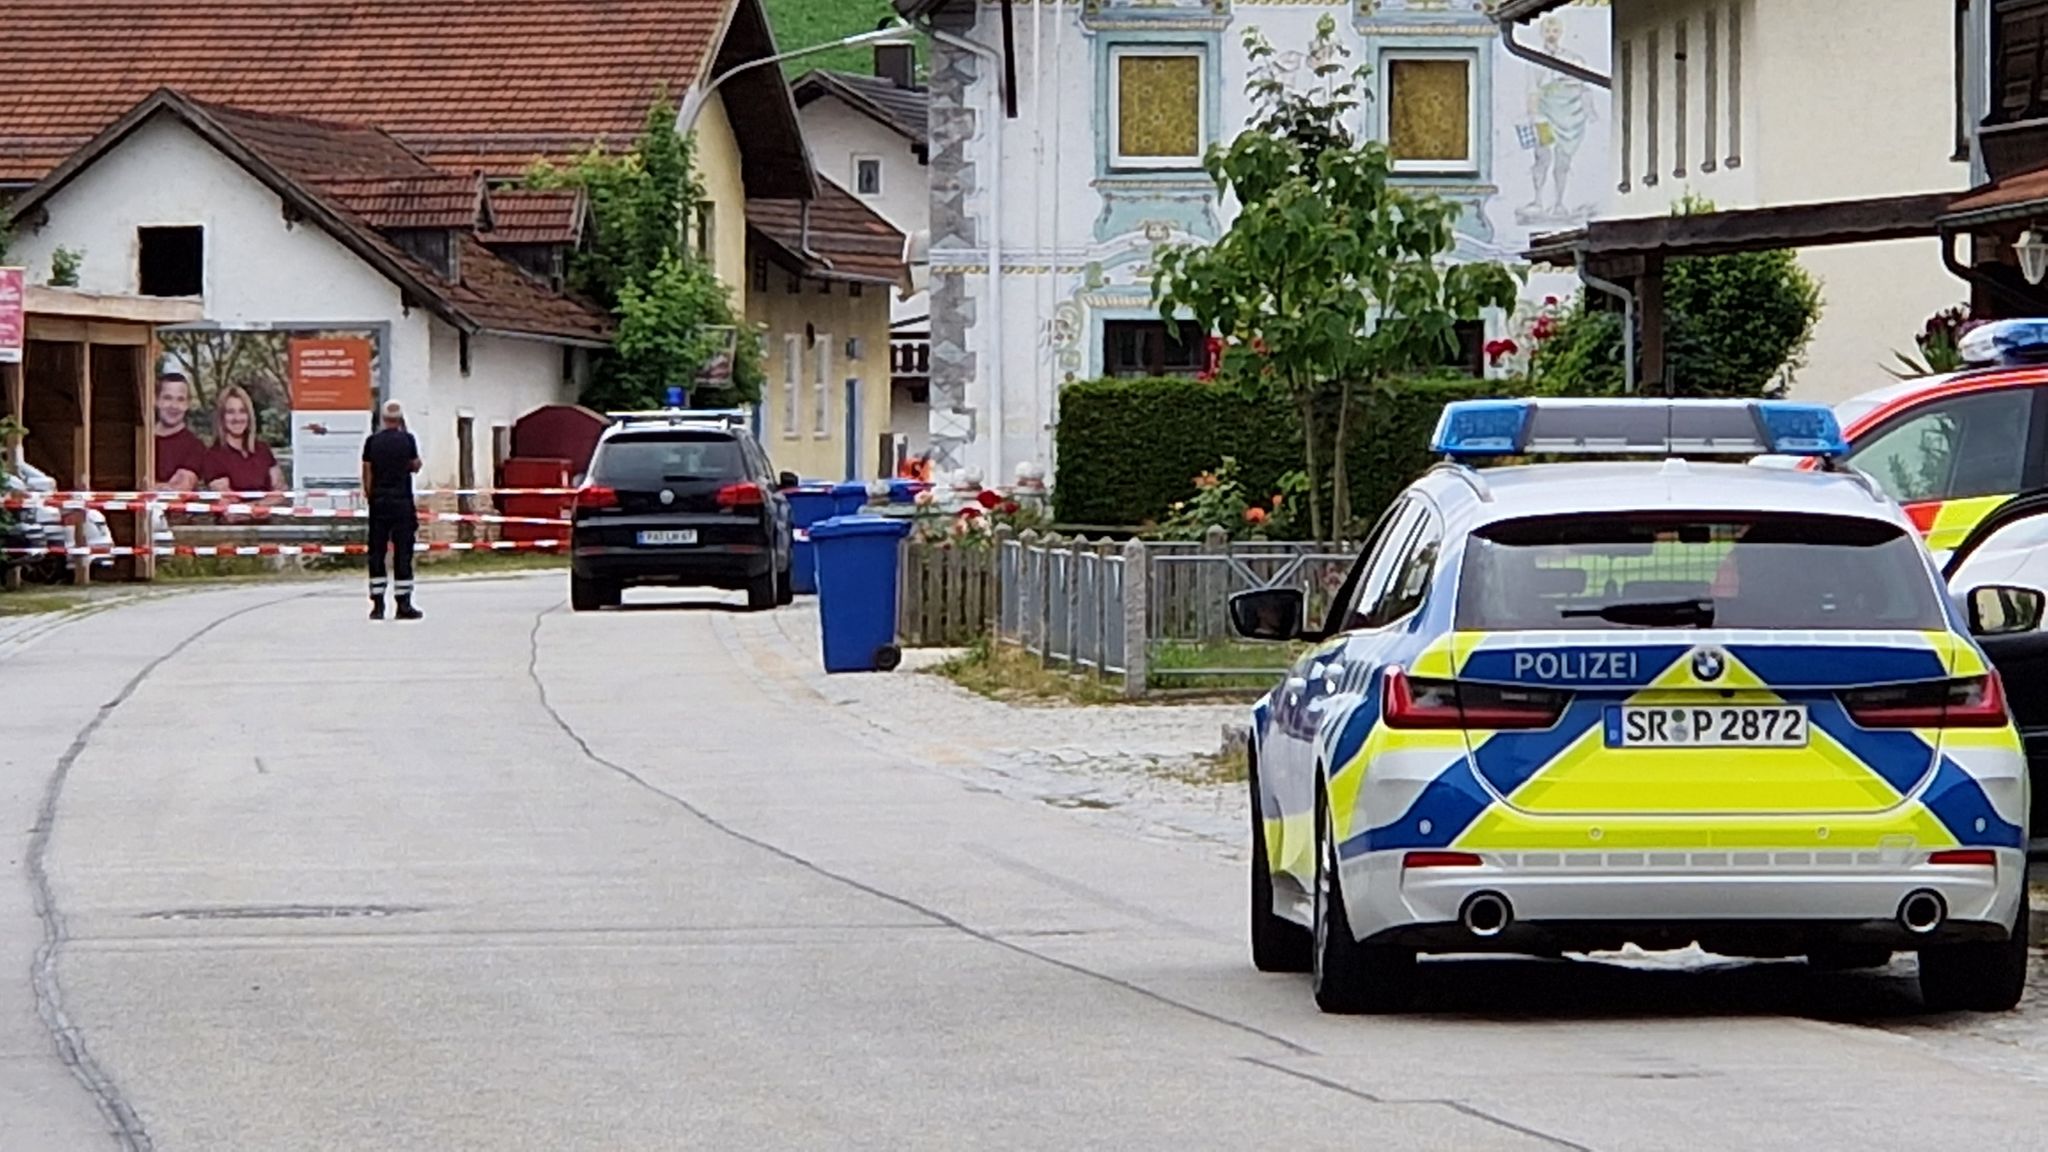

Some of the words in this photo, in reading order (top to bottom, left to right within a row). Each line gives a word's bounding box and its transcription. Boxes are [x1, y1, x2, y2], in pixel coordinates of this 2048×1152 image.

[1514, 652, 1637, 679] POLIZEI
[1626, 710, 1668, 742] SR
[1692, 709, 1713, 742] P
[1720, 709, 1801, 741] 2872
